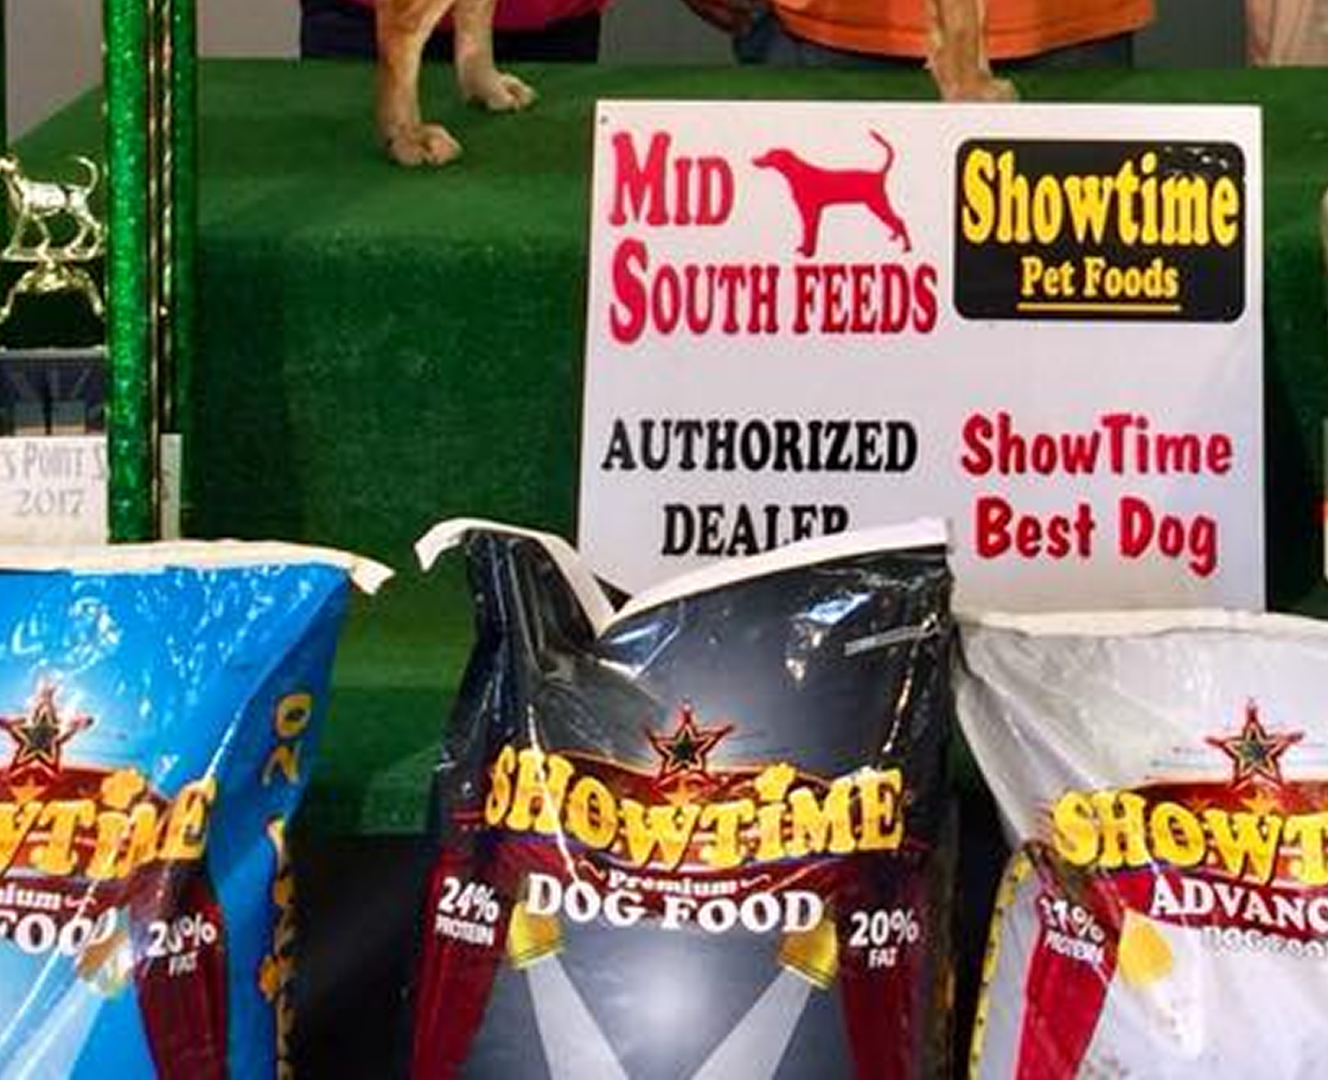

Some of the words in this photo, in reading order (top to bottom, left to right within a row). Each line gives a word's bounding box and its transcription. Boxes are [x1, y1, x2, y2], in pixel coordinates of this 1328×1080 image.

[961, 148, 1240, 248] Showtime
[608, 240, 780, 344] SOUTH
[793, 264, 939, 335] FEEDS
[1021, 257, 1076, 297] Pet
[1083, 256, 1180, 298] Foods
[602, 419, 919, 473] AUTHORIZED
[961, 413, 1233, 476] ShowTime
[975, 497, 1095, 559] Best
[1119, 497, 1219, 578] Dog
[438, 876, 499, 923] 24%
[526, 873, 646, 925] DOG
[661, 889, 825, 934] FOOD
[608, 870, 740, 896] Premium
[849, 906, 919, 948] 20%
